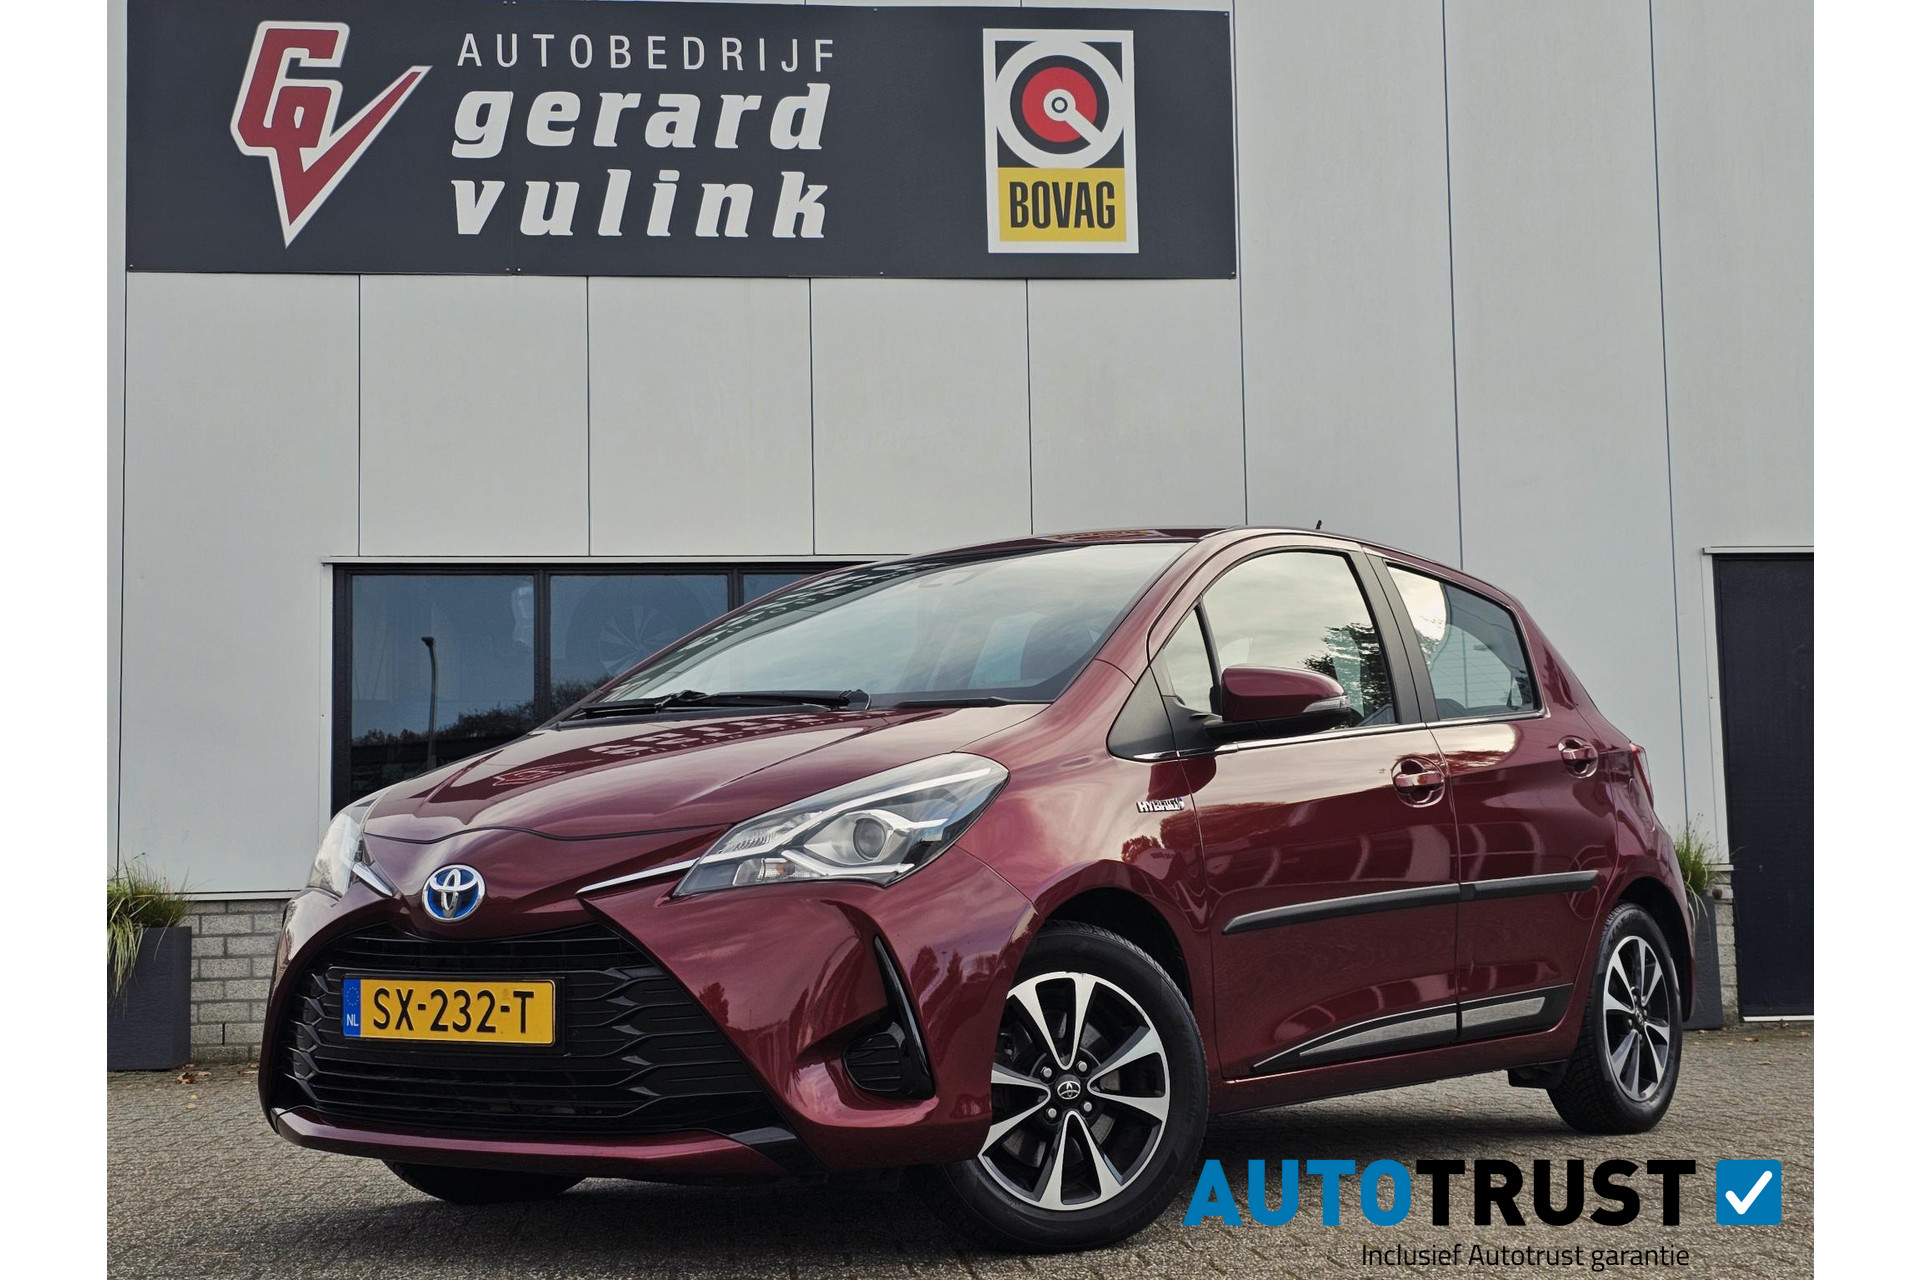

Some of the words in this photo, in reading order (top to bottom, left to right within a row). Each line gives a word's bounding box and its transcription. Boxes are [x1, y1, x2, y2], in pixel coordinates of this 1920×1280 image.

[457, 33, 834, 73] AUTOBEDRIJF
[451, 82, 831, 159] gerard
[450, 168, 828, 239] vulink
[1009, 180, 1116, 229] BOVAG
[346, 1013, 359, 1027] NL
[373, 987, 535, 1034] SX-232-T
